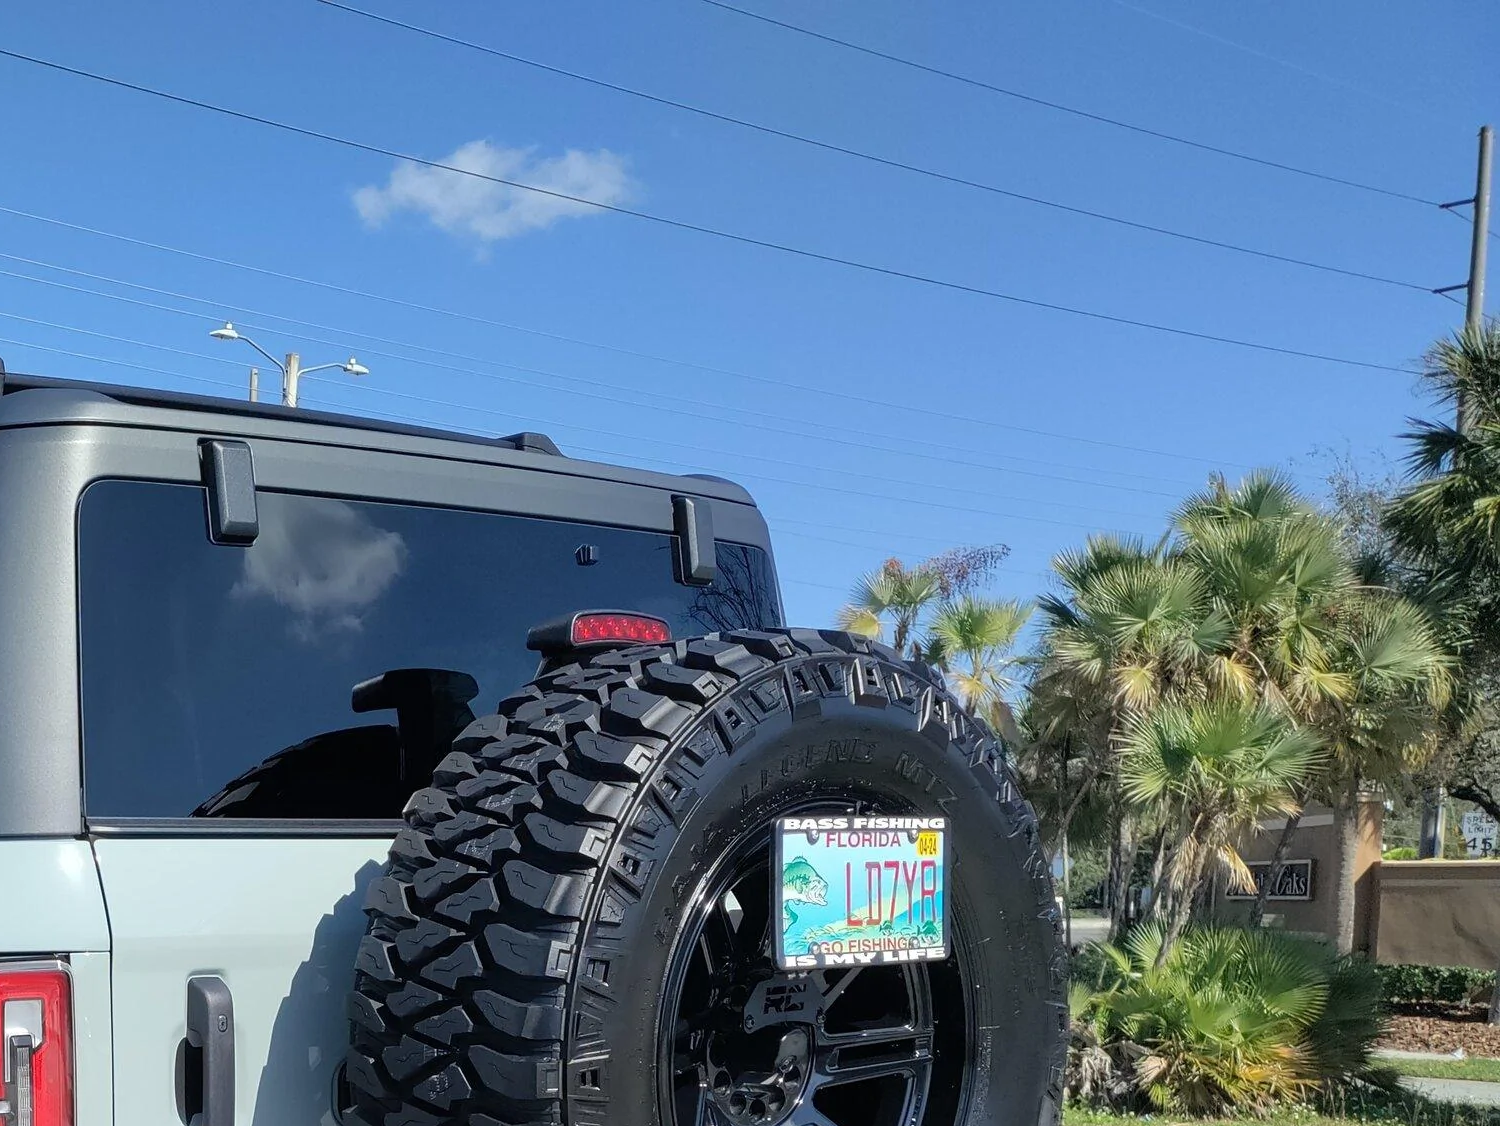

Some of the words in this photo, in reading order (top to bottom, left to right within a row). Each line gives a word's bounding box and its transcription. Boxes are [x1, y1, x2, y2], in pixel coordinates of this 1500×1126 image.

[784, 818, 848, 830] BASS
[853, 817, 945, 830] FISHING
[1466, 814, 1494, 824] SPE
[1468, 826, 1493, 834] LIMIT
[826, 831, 901, 848] FLORIDA
[1466, 837, 1493, 851] 45
[846, 860, 937, 926] LD7YR
[819, 941, 844, 955] GO
[848, 936, 907, 952] FISHING
[785, 955, 817, 967] IS
[825, 951, 876, 965] MY
[883, 947, 946, 962] LIFE
